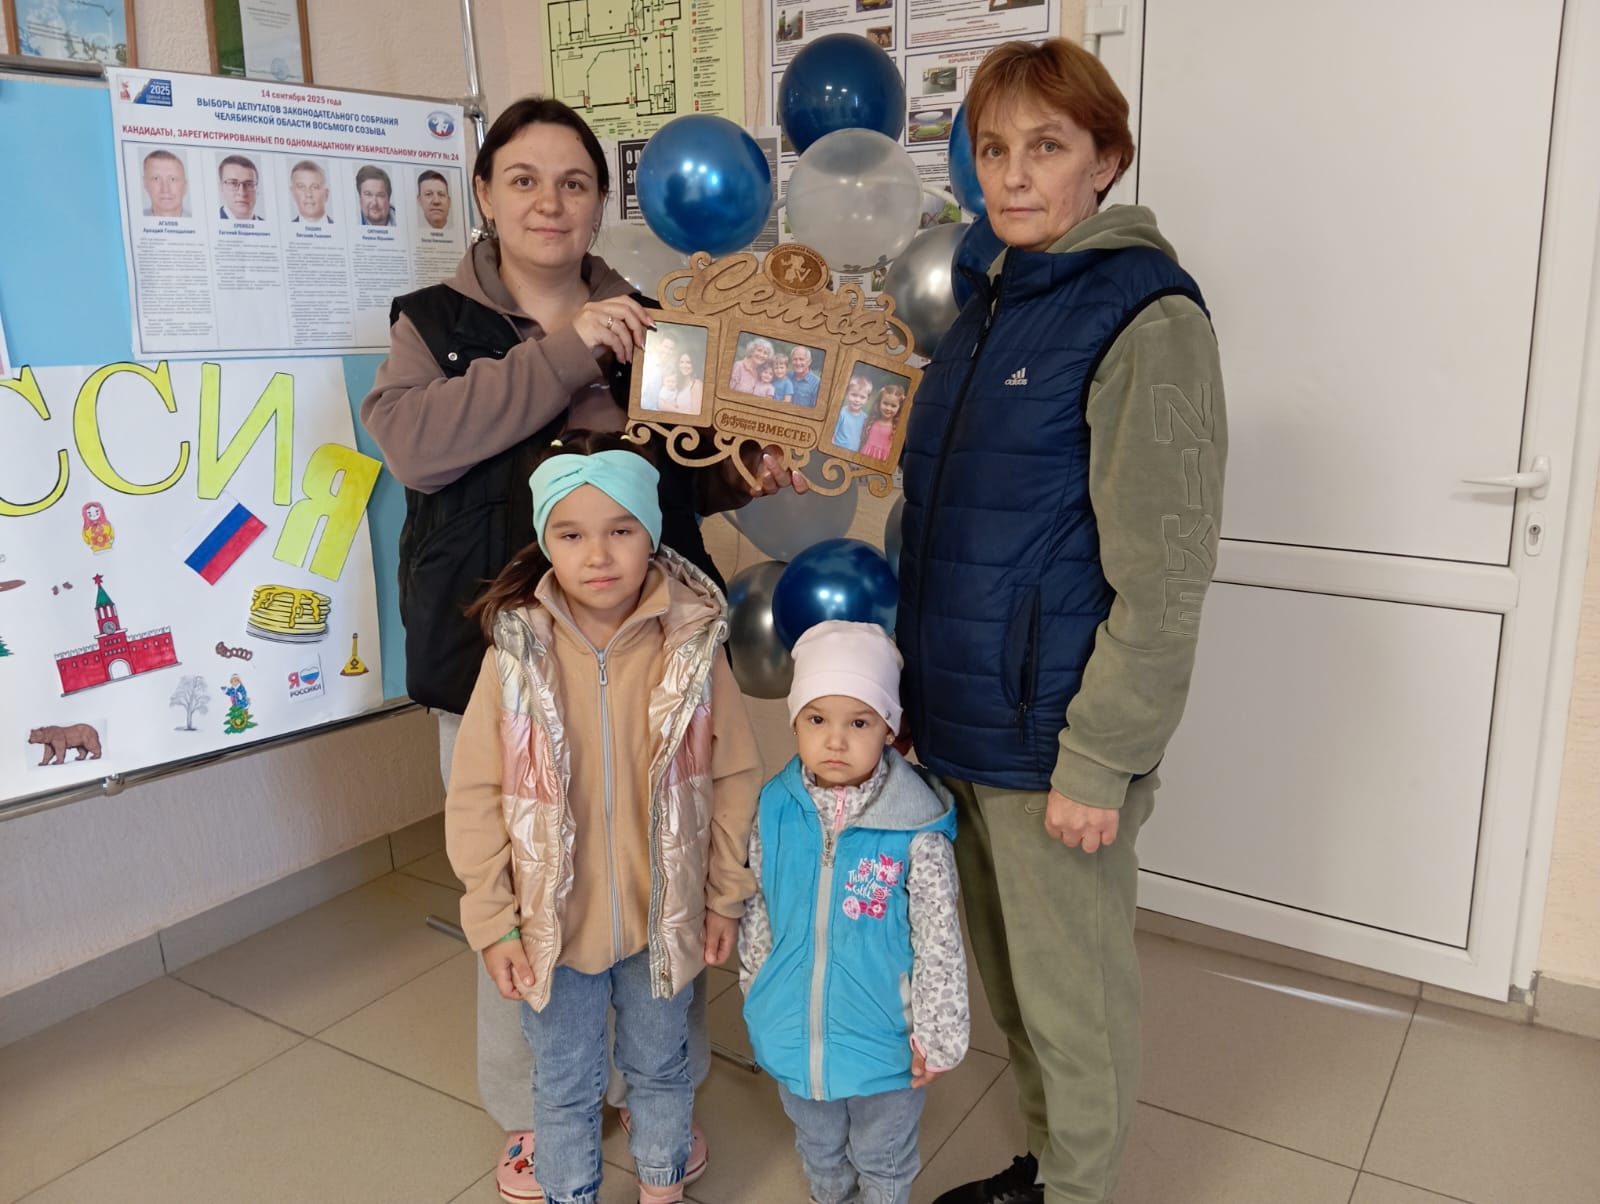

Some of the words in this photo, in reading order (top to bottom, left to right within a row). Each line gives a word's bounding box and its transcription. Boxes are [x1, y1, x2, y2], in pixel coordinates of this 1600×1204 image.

[150, 84, 171, 96] 2025
[261, 89, 270, 98] 14
[272, 91, 306, 102] сентября
[307, 94, 326, 104] 2025
[327, 97, 342, 106] года
[197, 97, 236, 110] ВЫБОРЫ
[237, 101, 282, 114] ДЕПУТАТОВ
[283, 105, 360, 122] ЗАКОНОДАТЕЛЬНОГО
[361, 114, 399, 127] СОБРАНИЯ
[214, 112, 275, 126] ЧЕЛЯБИНСКОЙ
[277, 116, 311, 129] ОБЛАСТИ
[312, 121, 354, 133] ВОСЬМОГО
[355, 125, 386, 137] СОЗЫВА
[122, 125, 176, 138] КАНДИДАТЫ,
[177, 129, 273, 144] ЗАРЕГИСТРИРОВАННЫЕ
[274, 137, 285, 145] ПО
[286, 138, 355, 151] ОДНОМАНДАТНОМУ
[356, 145, 417, 157] ИЗБИРАТЕЛЬНОМУ
[418, 151, 442, 160] ОКРУГУ
[1004, 378, 1029, 386] adidas
[757, 423, 811, 442] ВМЕСТЕ!
[1151, 382, 1216, 638] NIKE
[287, 671, 300, 689] Я
